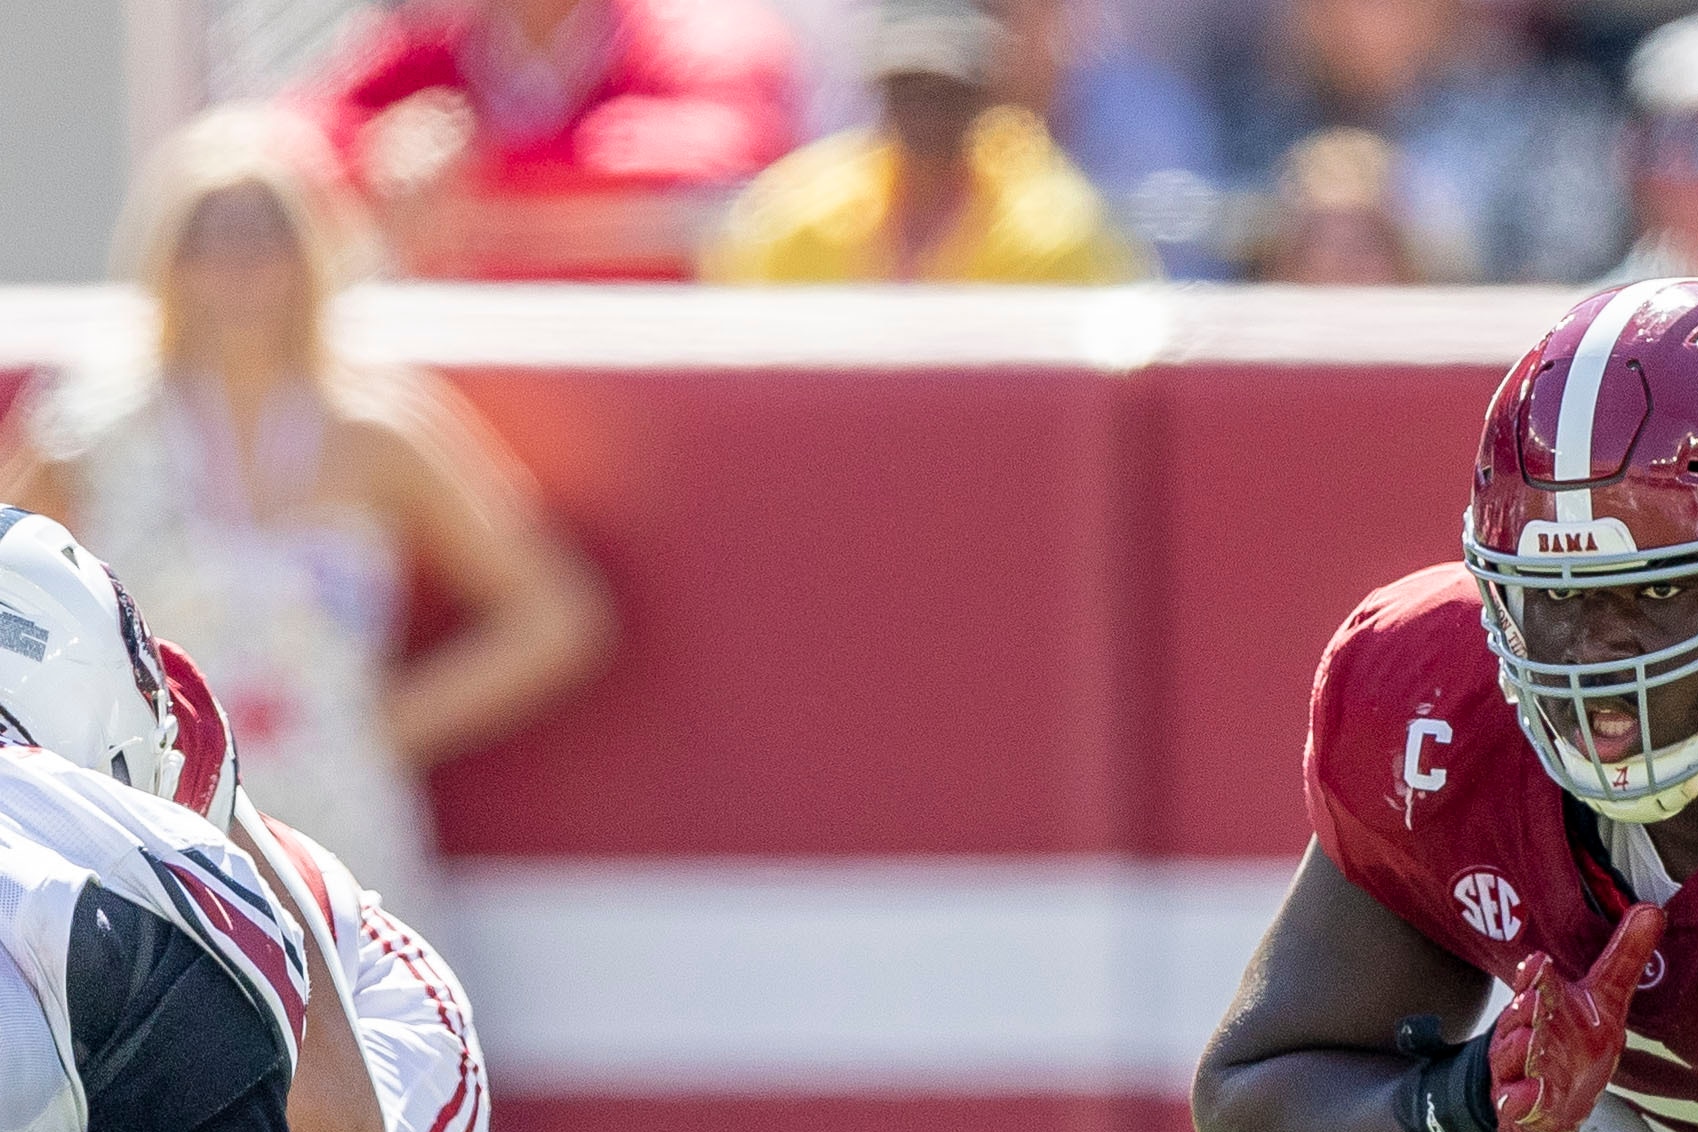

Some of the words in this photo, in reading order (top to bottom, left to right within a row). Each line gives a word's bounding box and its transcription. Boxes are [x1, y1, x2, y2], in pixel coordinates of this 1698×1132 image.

[1537, 532, 1599, 553] BAMA
[1403, 718, 1453, 791] C
[1453, 873, 1522, 942] SEC
